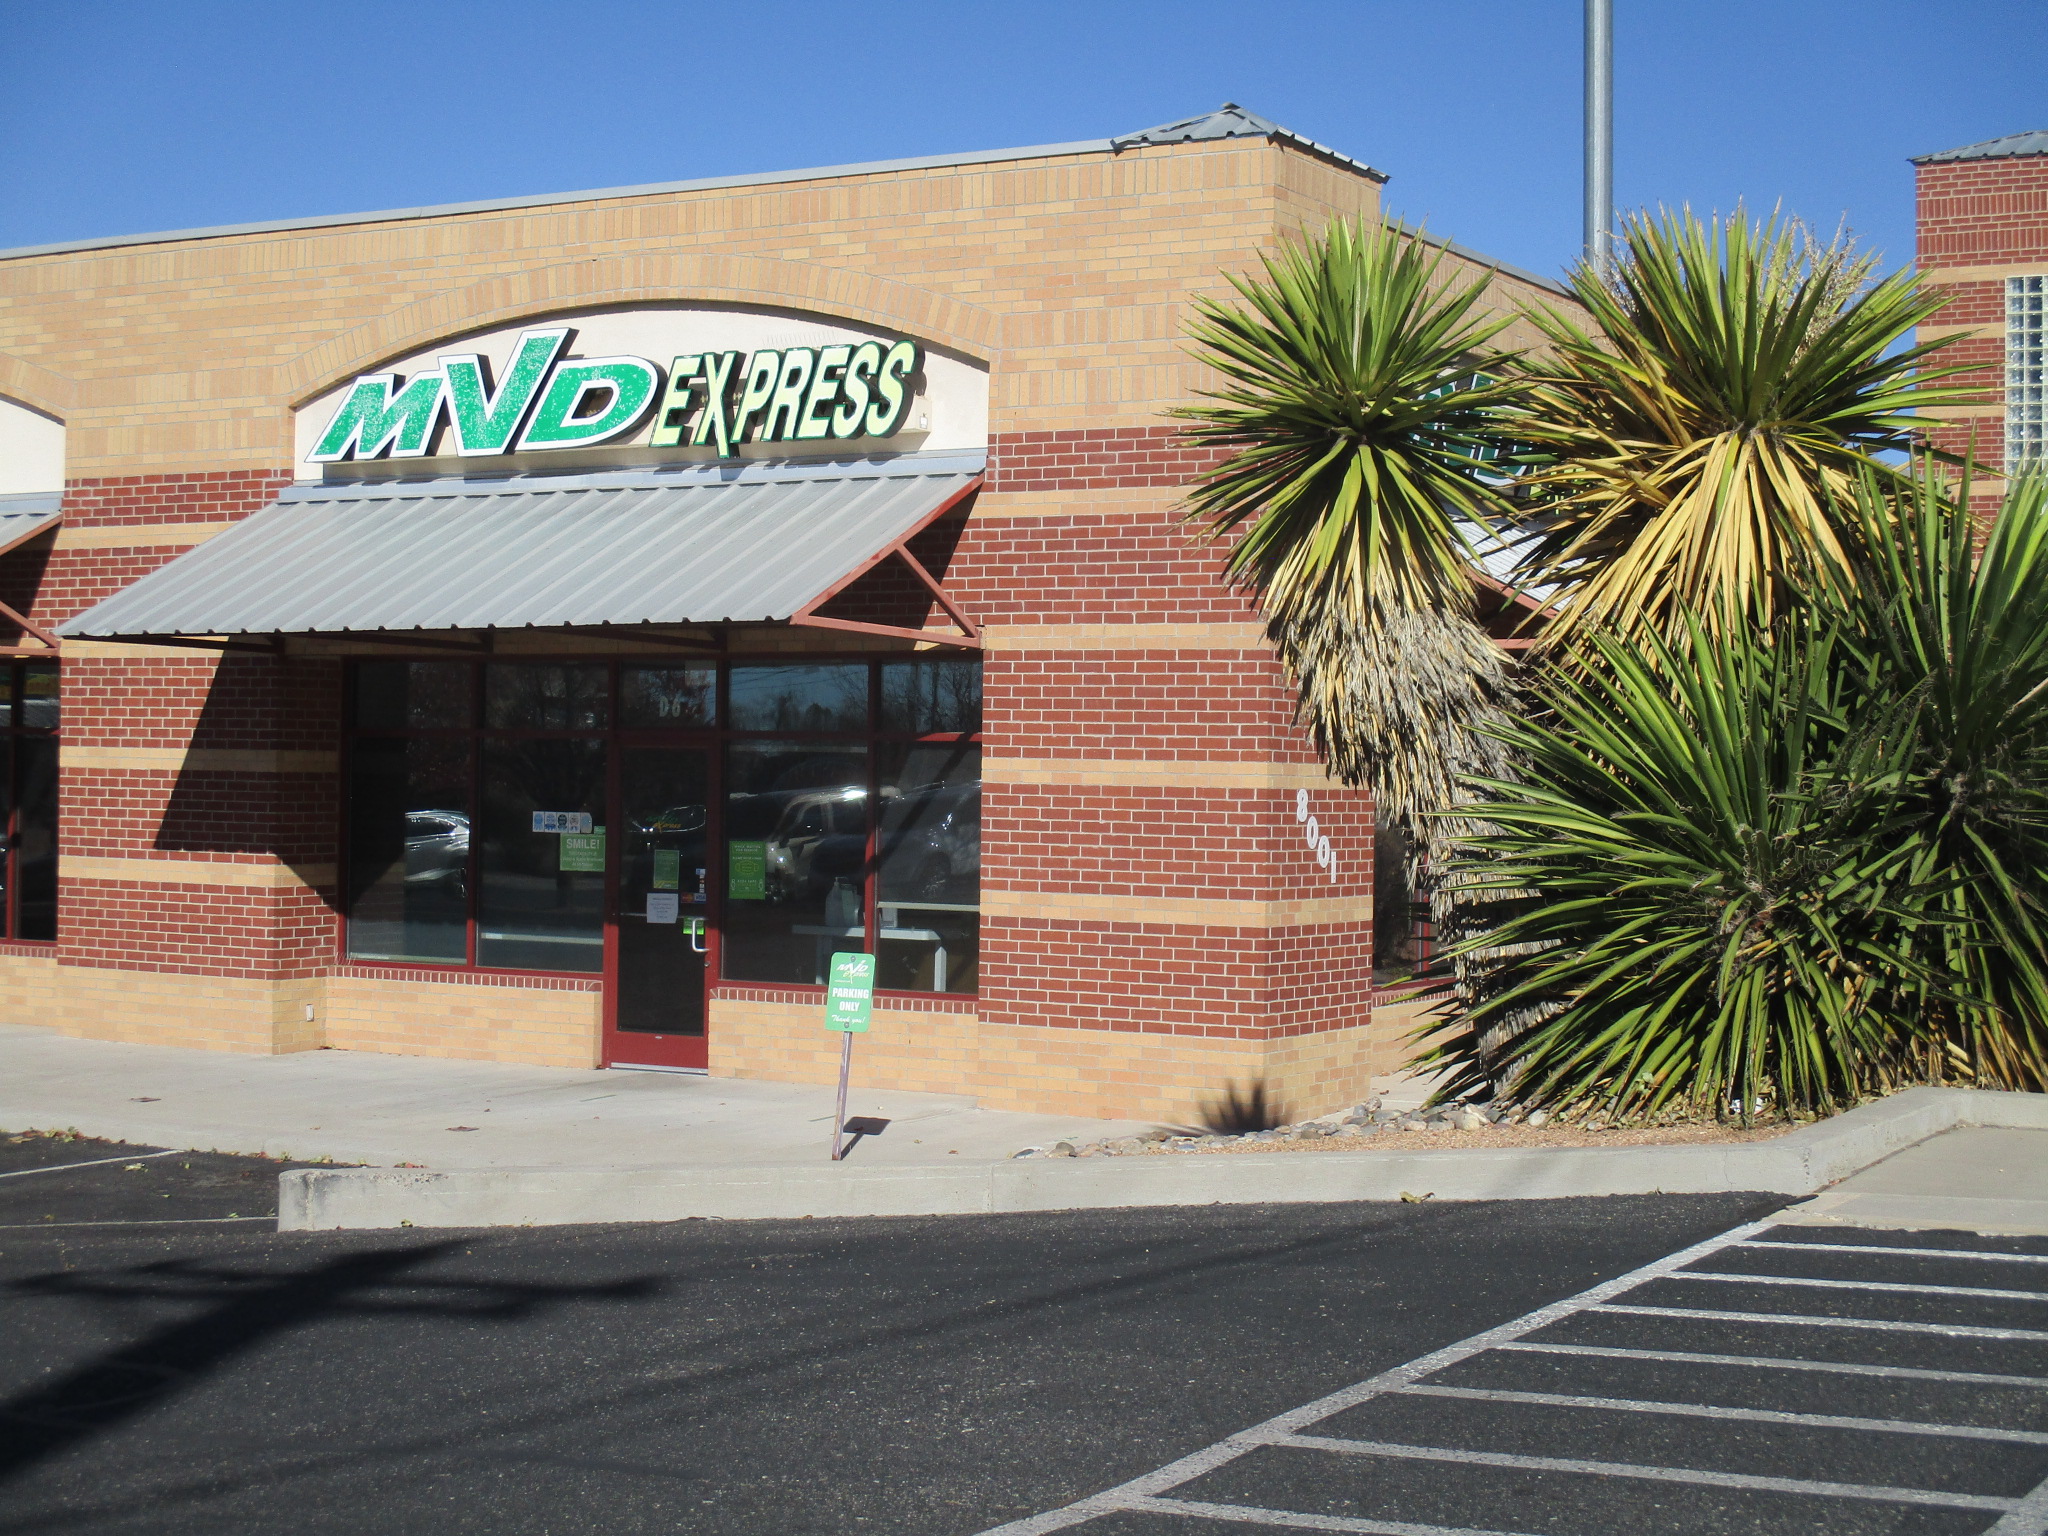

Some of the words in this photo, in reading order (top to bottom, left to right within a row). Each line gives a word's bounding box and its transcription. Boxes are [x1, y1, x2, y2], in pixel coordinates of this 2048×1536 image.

[304, 327, 660, 463] MVD
[649, 340, 919, 459] EXPRESS
[1296, 788, 1336, 884] 8001
[566, 838, 600, 849] SMILE!
[832, 987, 869, 999] PARKING
[839, 1001, 860, 1012] ONLY
[831, 1014, 850, 1023] Thank
